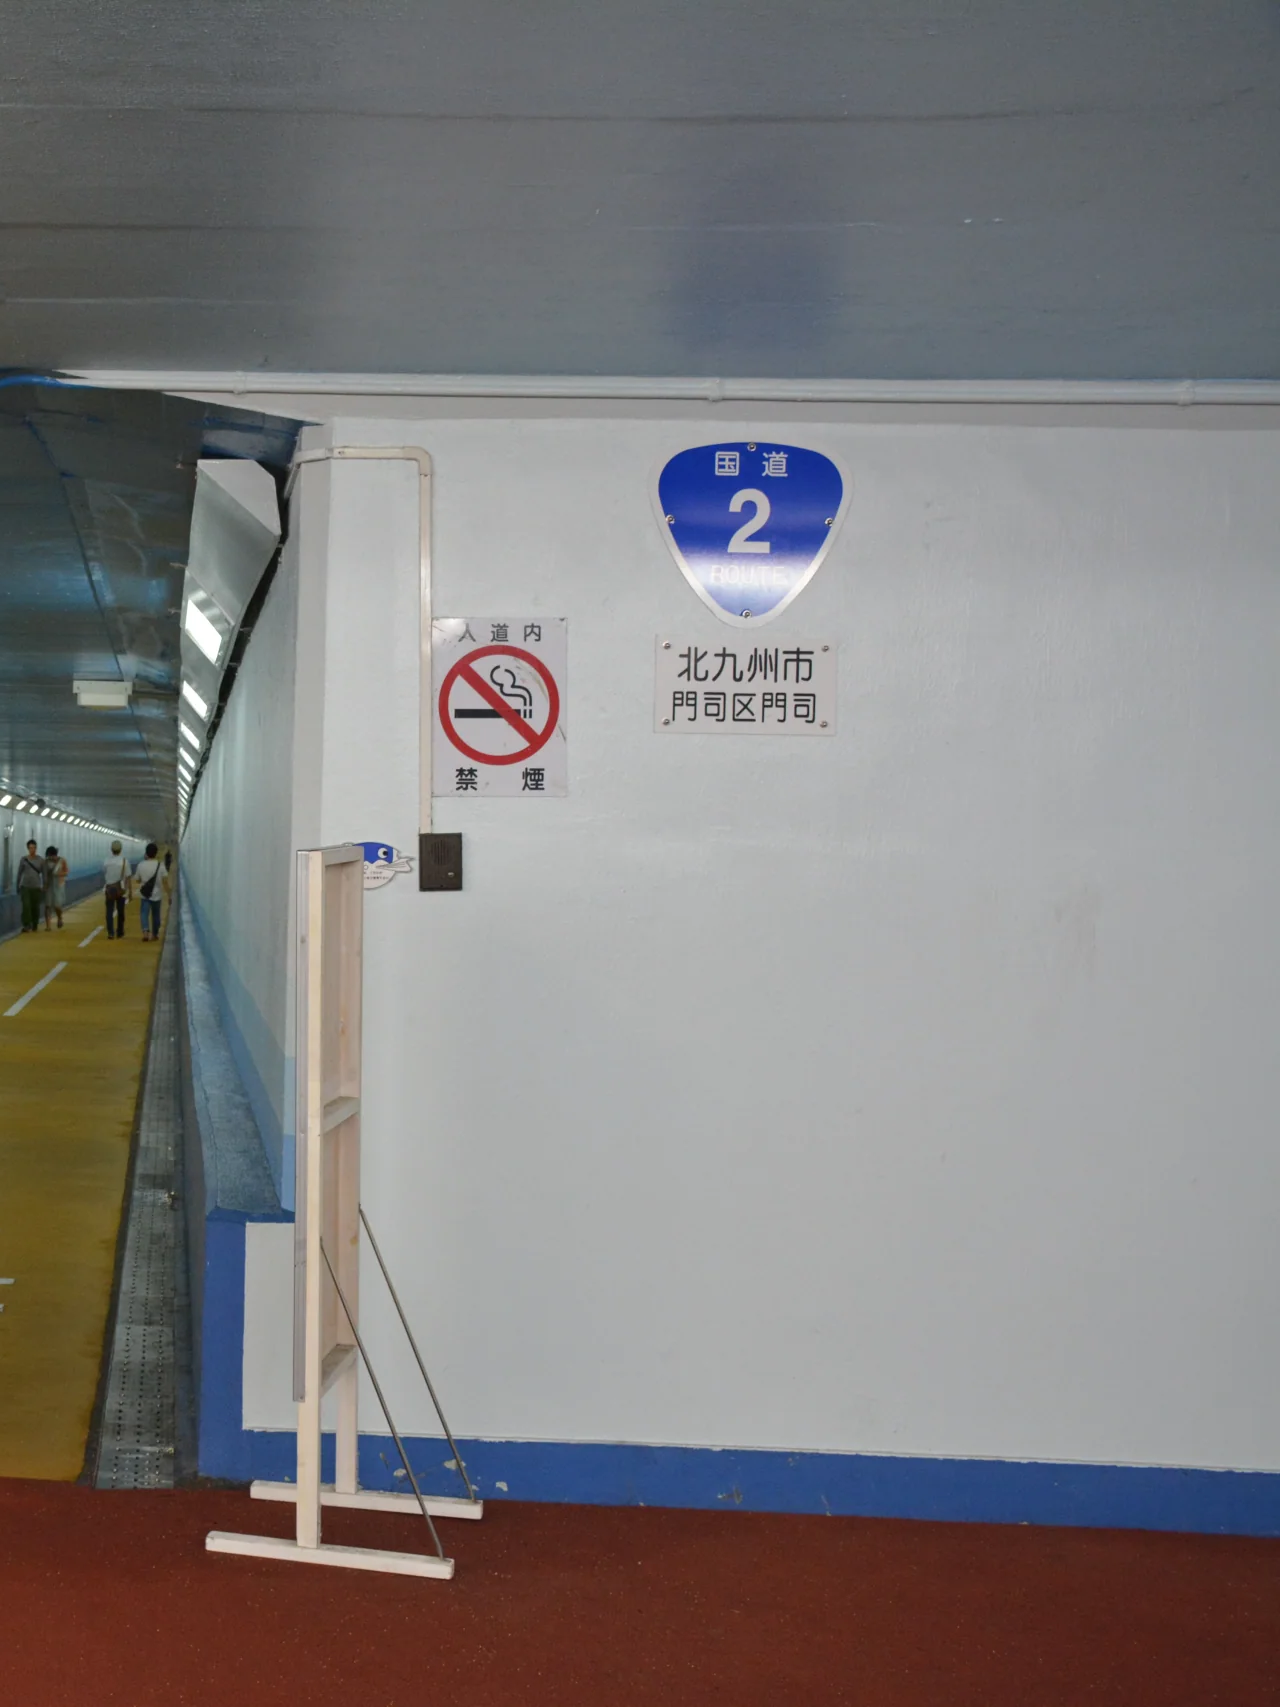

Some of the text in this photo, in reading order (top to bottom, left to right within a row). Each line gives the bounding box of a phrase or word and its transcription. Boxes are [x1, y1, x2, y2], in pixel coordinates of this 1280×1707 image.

[714, 451, 789, 478] 国道
[727, 488, 771, 554] 2
[710, 564, 788, 586] ROUTE
[457, 623, 542, 643] 人道内
[677, 646, 815, 684] 北九州市
[671, 690, 817, 724] 門司区門司
[455, 767, 545, 791] 禁煙
